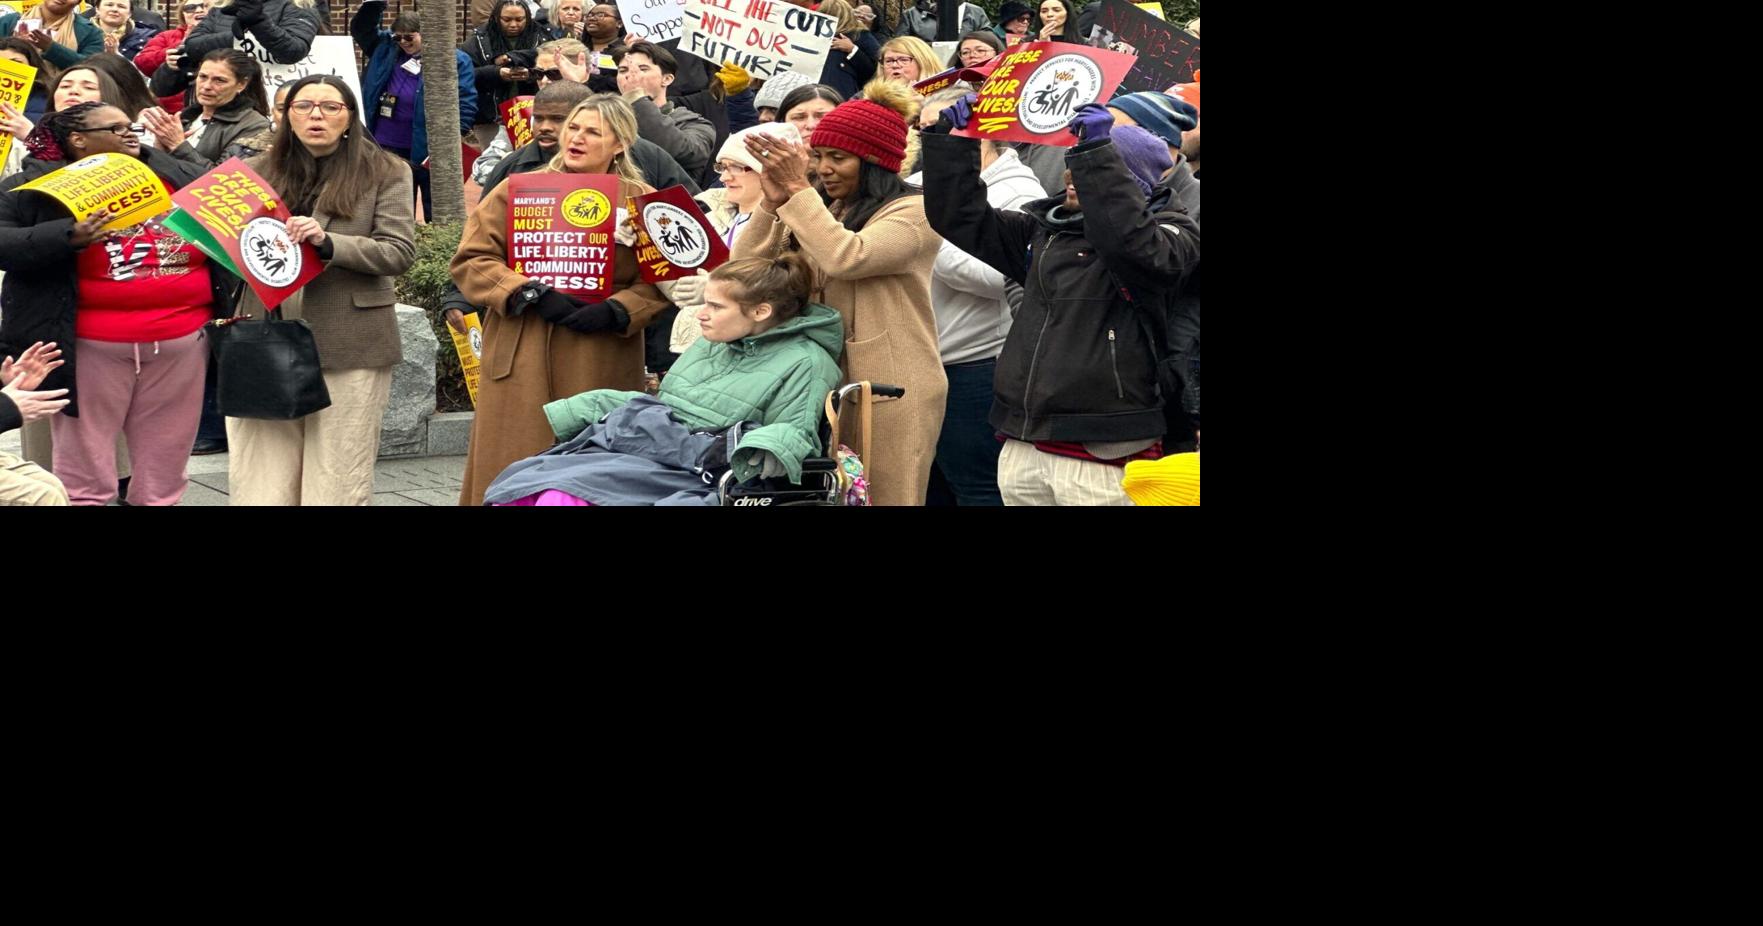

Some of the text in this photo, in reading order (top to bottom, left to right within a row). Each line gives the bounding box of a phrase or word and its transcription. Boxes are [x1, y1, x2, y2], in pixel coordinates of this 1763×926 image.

[785, 8, 836, 38] CUTS
[700, 11, 789, 56] NOT OUR
[1001, 50, 1043, 67] THESE
[981, 79, 1020, 96] OUR
[52, 165, 110, 193] PROTECT
[211, 173, 251, 197] ARE
[85, 172, 150, 208] COMMUNITY
[231, 170, 277, 211] THESE
[209, 185, 252, 214] OUR
[514, 197, 556, 205] MARYLAND'S
[190, 187, 250, 231] LIVES!
[514, 206, 554, 217] BUDGET
[514, 218, 554, 230] MUST
[514, 231, 608, 245] PROTECT OUR
[514, 245, 608, 260] LIFE, LIBERTY,
[514, 260, 606, 275] & COMMUNITY
[734, 495, 773, 506] drive
